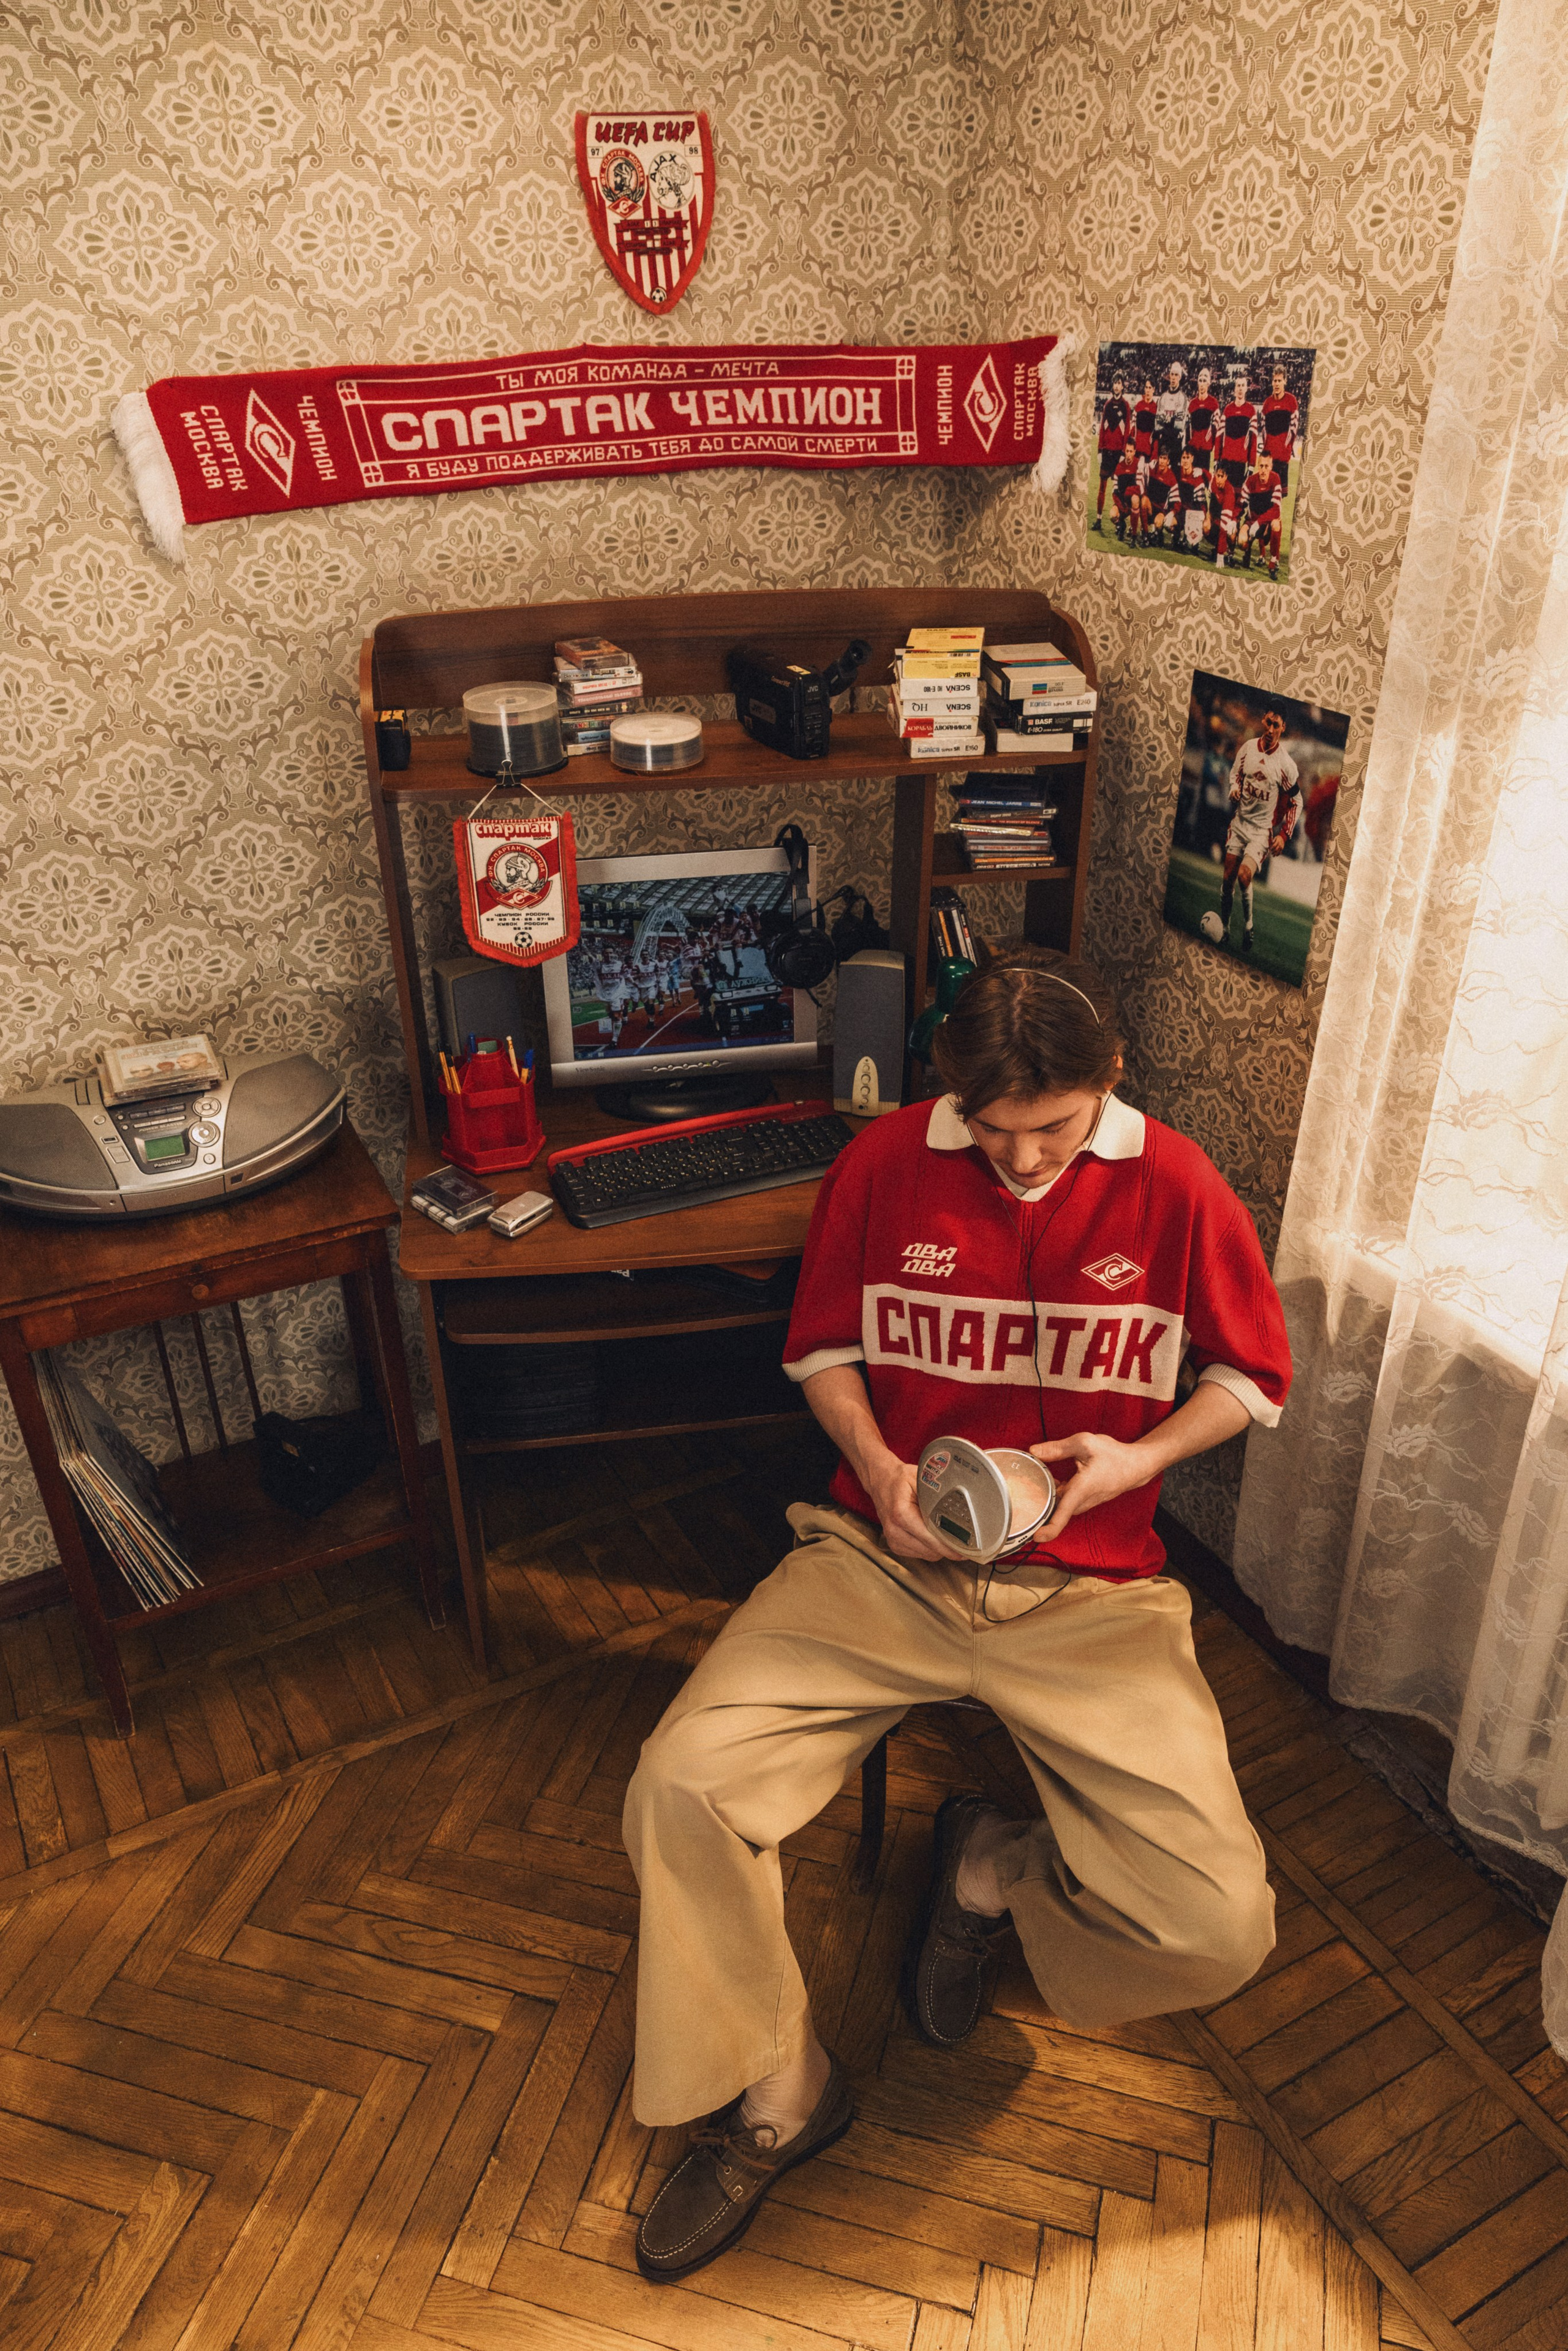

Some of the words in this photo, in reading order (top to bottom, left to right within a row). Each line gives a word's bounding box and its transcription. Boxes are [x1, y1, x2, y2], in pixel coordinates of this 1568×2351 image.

[595, 121, 648, 148] UEFA
[652, 121, 695, 144] CUP
[602, 150, 625, 169] СПАРТАК
[628, 153, 644, 183] МОСКВА
[650, 154, 677, 183] AJAX
[496, 374, 525, 390] ТЫ
[534, 367, 578, 386] МОЯ
[587, 363, 687, 382] КОМАНДА
[711, 361, 779, 378] МЕЧТА
[381, 392, 655, 451] СПАРТАК
[671, 387, 882, 428] ЧЕМПИОН
[937, 365, 953, 445] ЧЕМПИОН
[1014, 363, 1025, 440] СПАРТАК
[1026, 366, 1038, 437] МОСКВА
[180, 412, 224, 490] МОСКВА
[200, 405, 247, 491] СПАРТАК
[296, 395, 337, 481] ЧЕМПИОН
[407, 464, 419, 478] Я
[426, 458, 478, 478] БУДУ
[486, 443, 643, 470] ПОДДЕРЖИВАТЬ
[649, 439, 691, 456] ТЕБЯ
[698, 436, 725, 452] ДО
[731, 434, 799, 451] САМОЙ
[805, 437, 877, 453] СМЕРТИ
[912, 703, 928, 711] HQ
[488, 866, 493, 877] ФК
[491, 845, 521, 862] СПАРТАК
[524, 848, 545, 872] МОСКВА
[154, 1160, 183, 1168] Panasonic
[900, 1259, 956, 1278] ДВА
[901, 1243, 957, 1261] ДВА
[876, 1296, 1168, 1384] СПАРТАК
